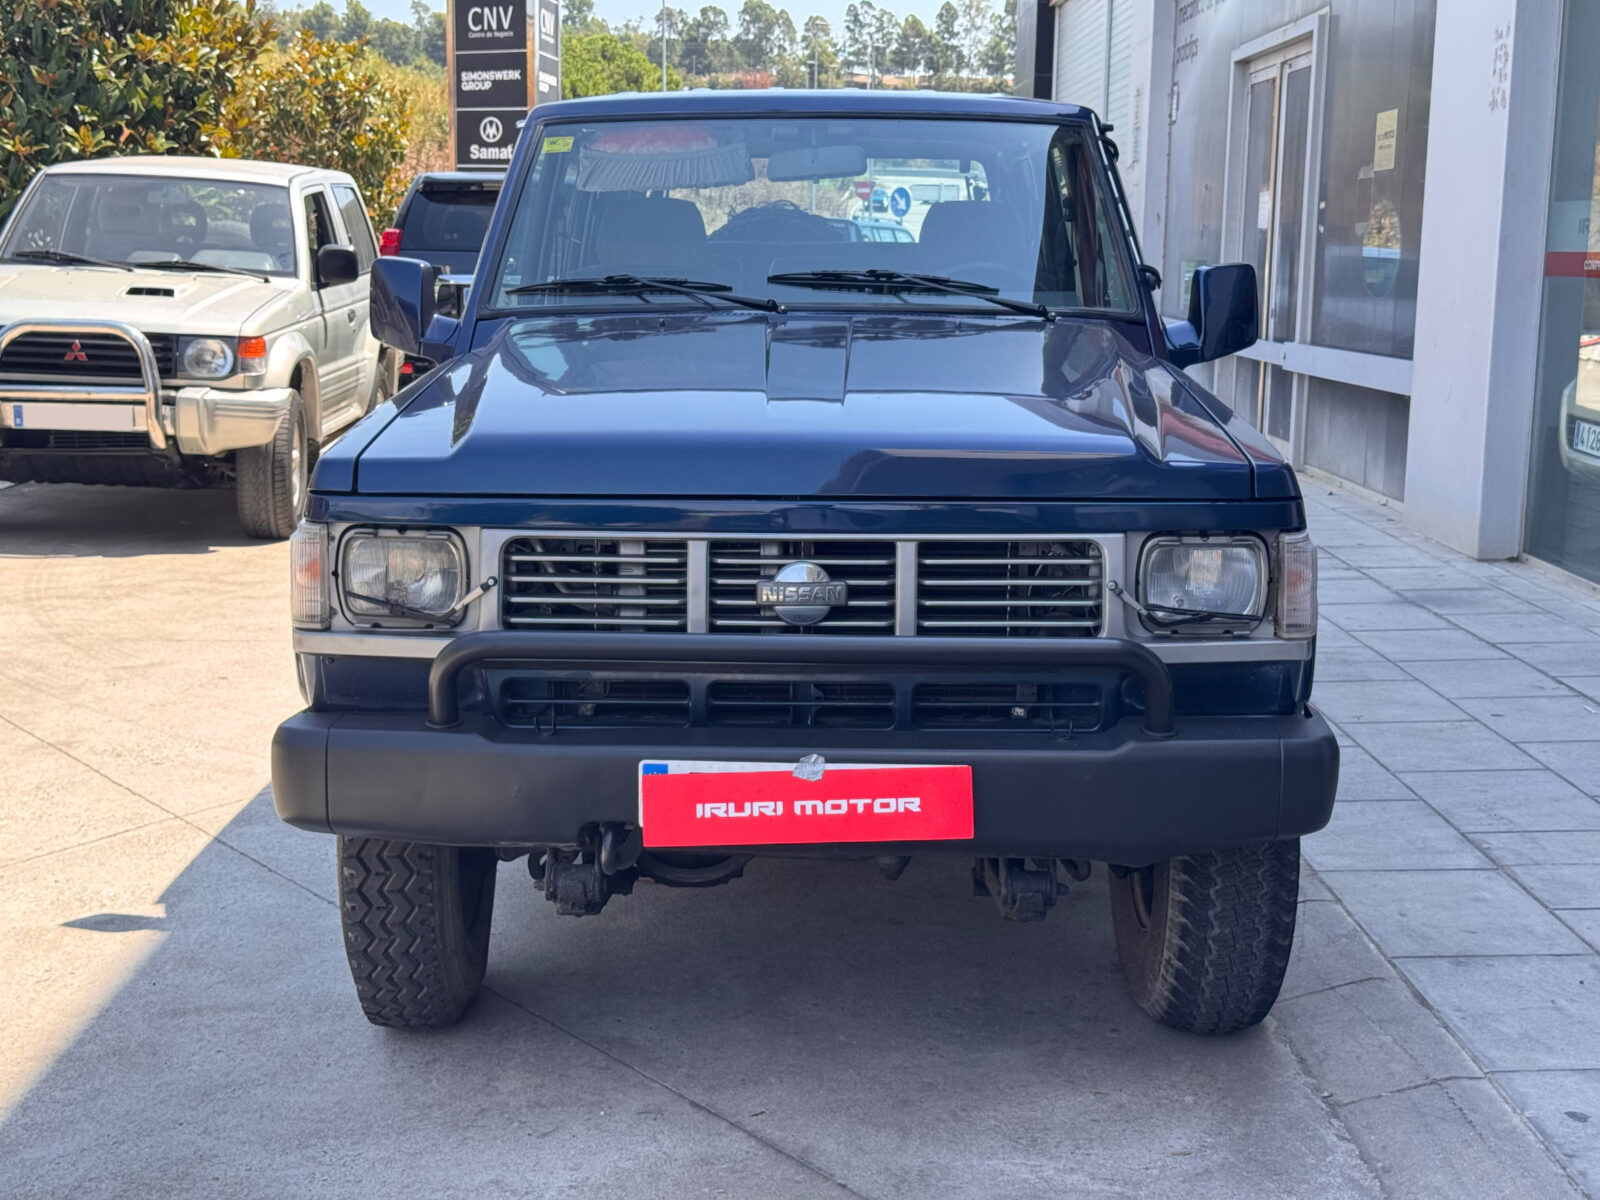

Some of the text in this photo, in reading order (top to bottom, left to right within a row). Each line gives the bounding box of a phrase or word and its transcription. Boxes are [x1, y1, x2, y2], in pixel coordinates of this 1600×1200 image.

[468, 5, 513, 31] CNV
[461, 69, 521, 82] SIMONSWERK
[461, 81, 492, 91] GROUP
[761, 586, 841, 602] NISSAN
[696, 797, 921, 818] IRURI MOTOR
